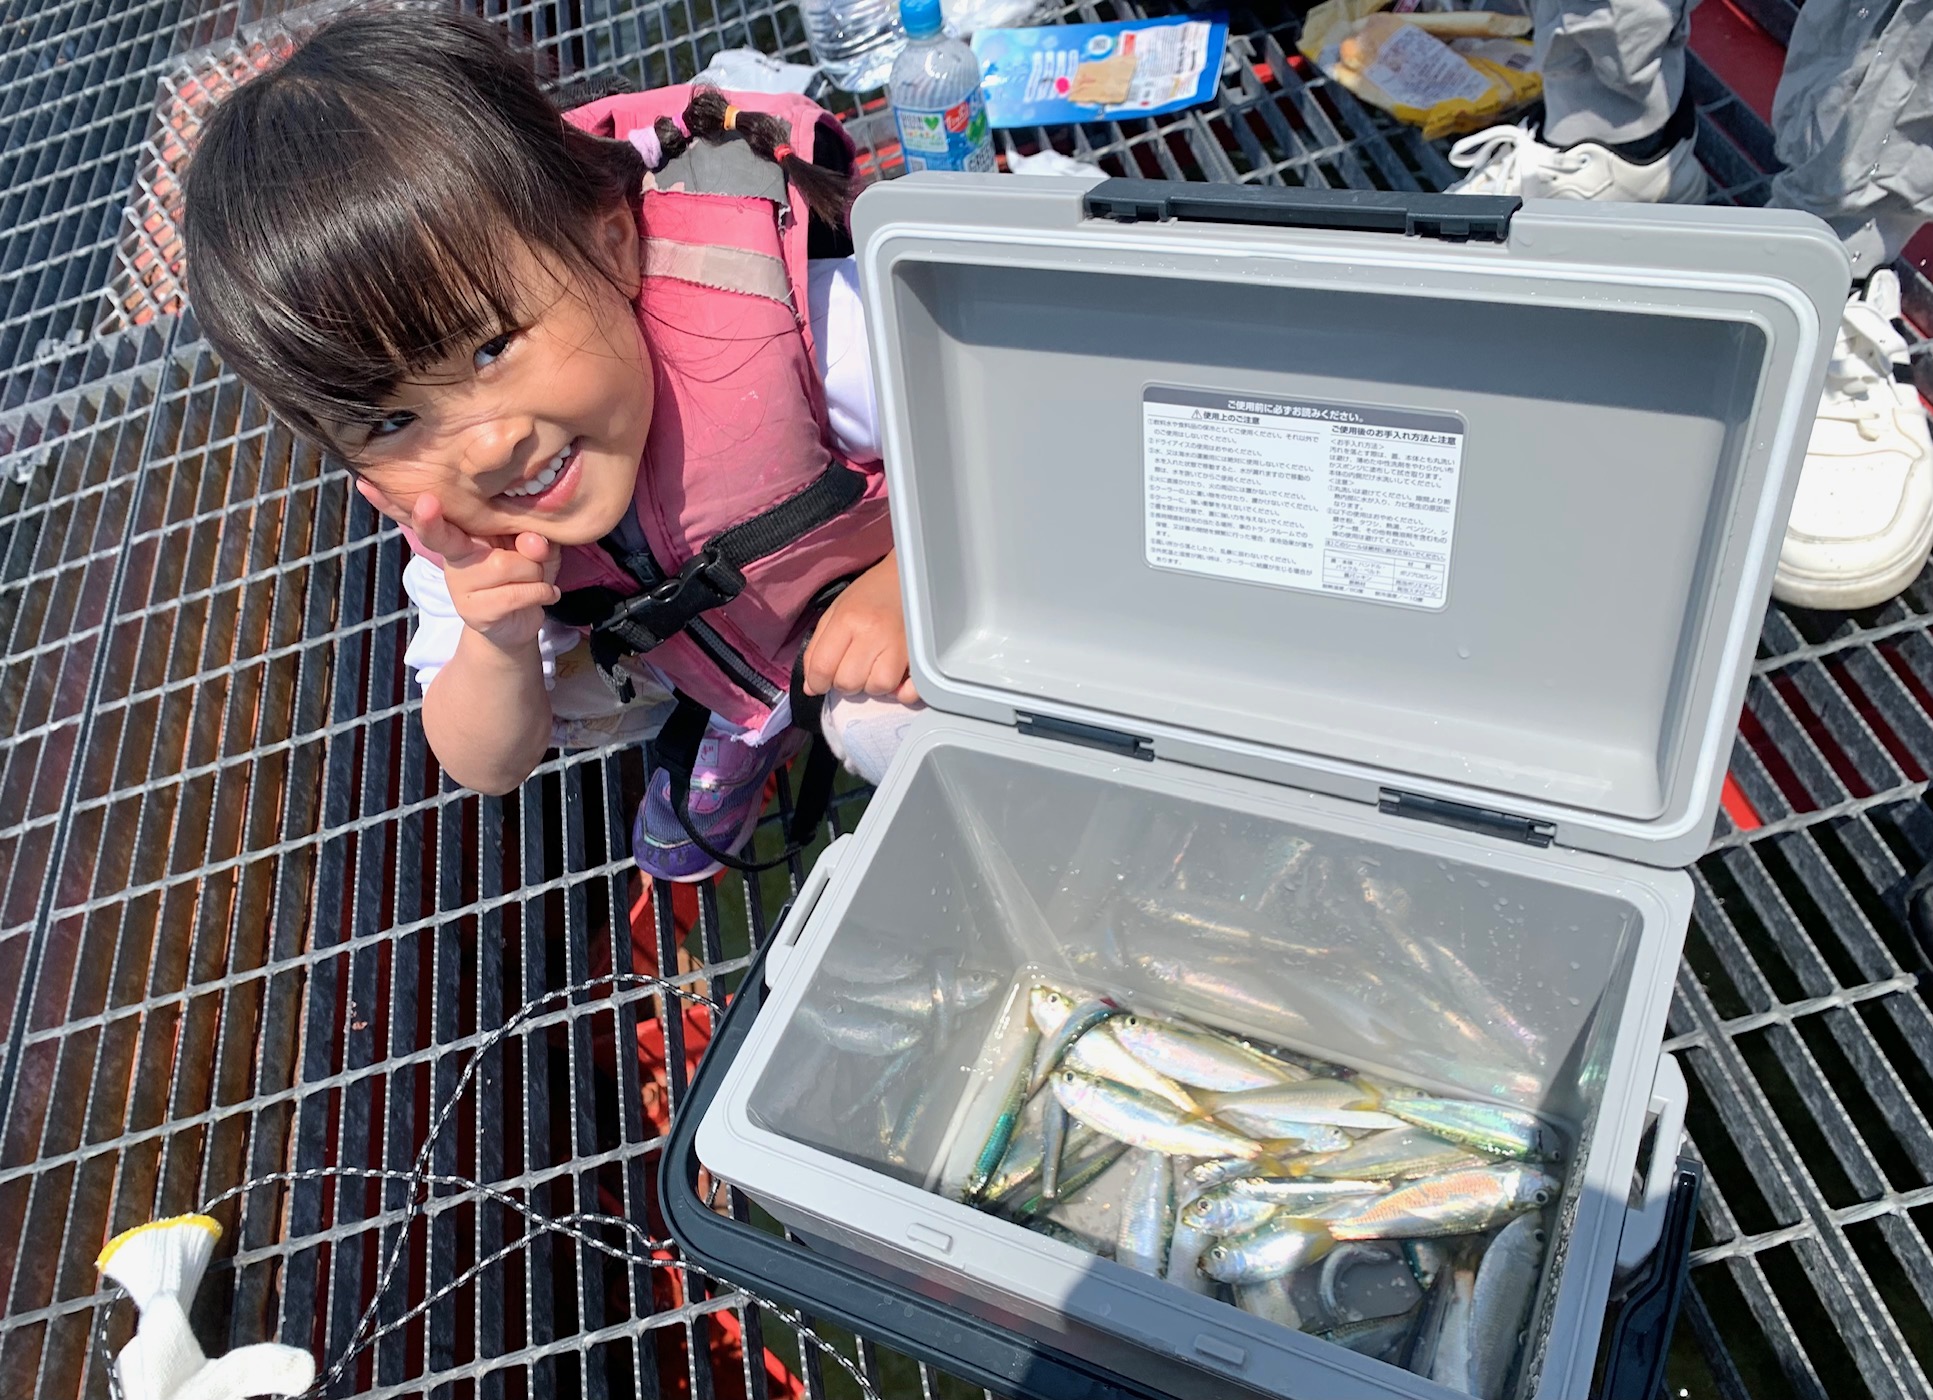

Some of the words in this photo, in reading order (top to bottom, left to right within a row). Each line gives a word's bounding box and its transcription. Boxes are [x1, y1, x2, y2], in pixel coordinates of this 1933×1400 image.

[1203, 412, 1259, 424] 使用上のご注意
[1227, 400, 1365, 422] ご使用前に必ずお読みください。
[1331, 424, 1456, 445] ご使用後のお手入れ方法と注意
[1334, 500, 1363, 509] なります。
